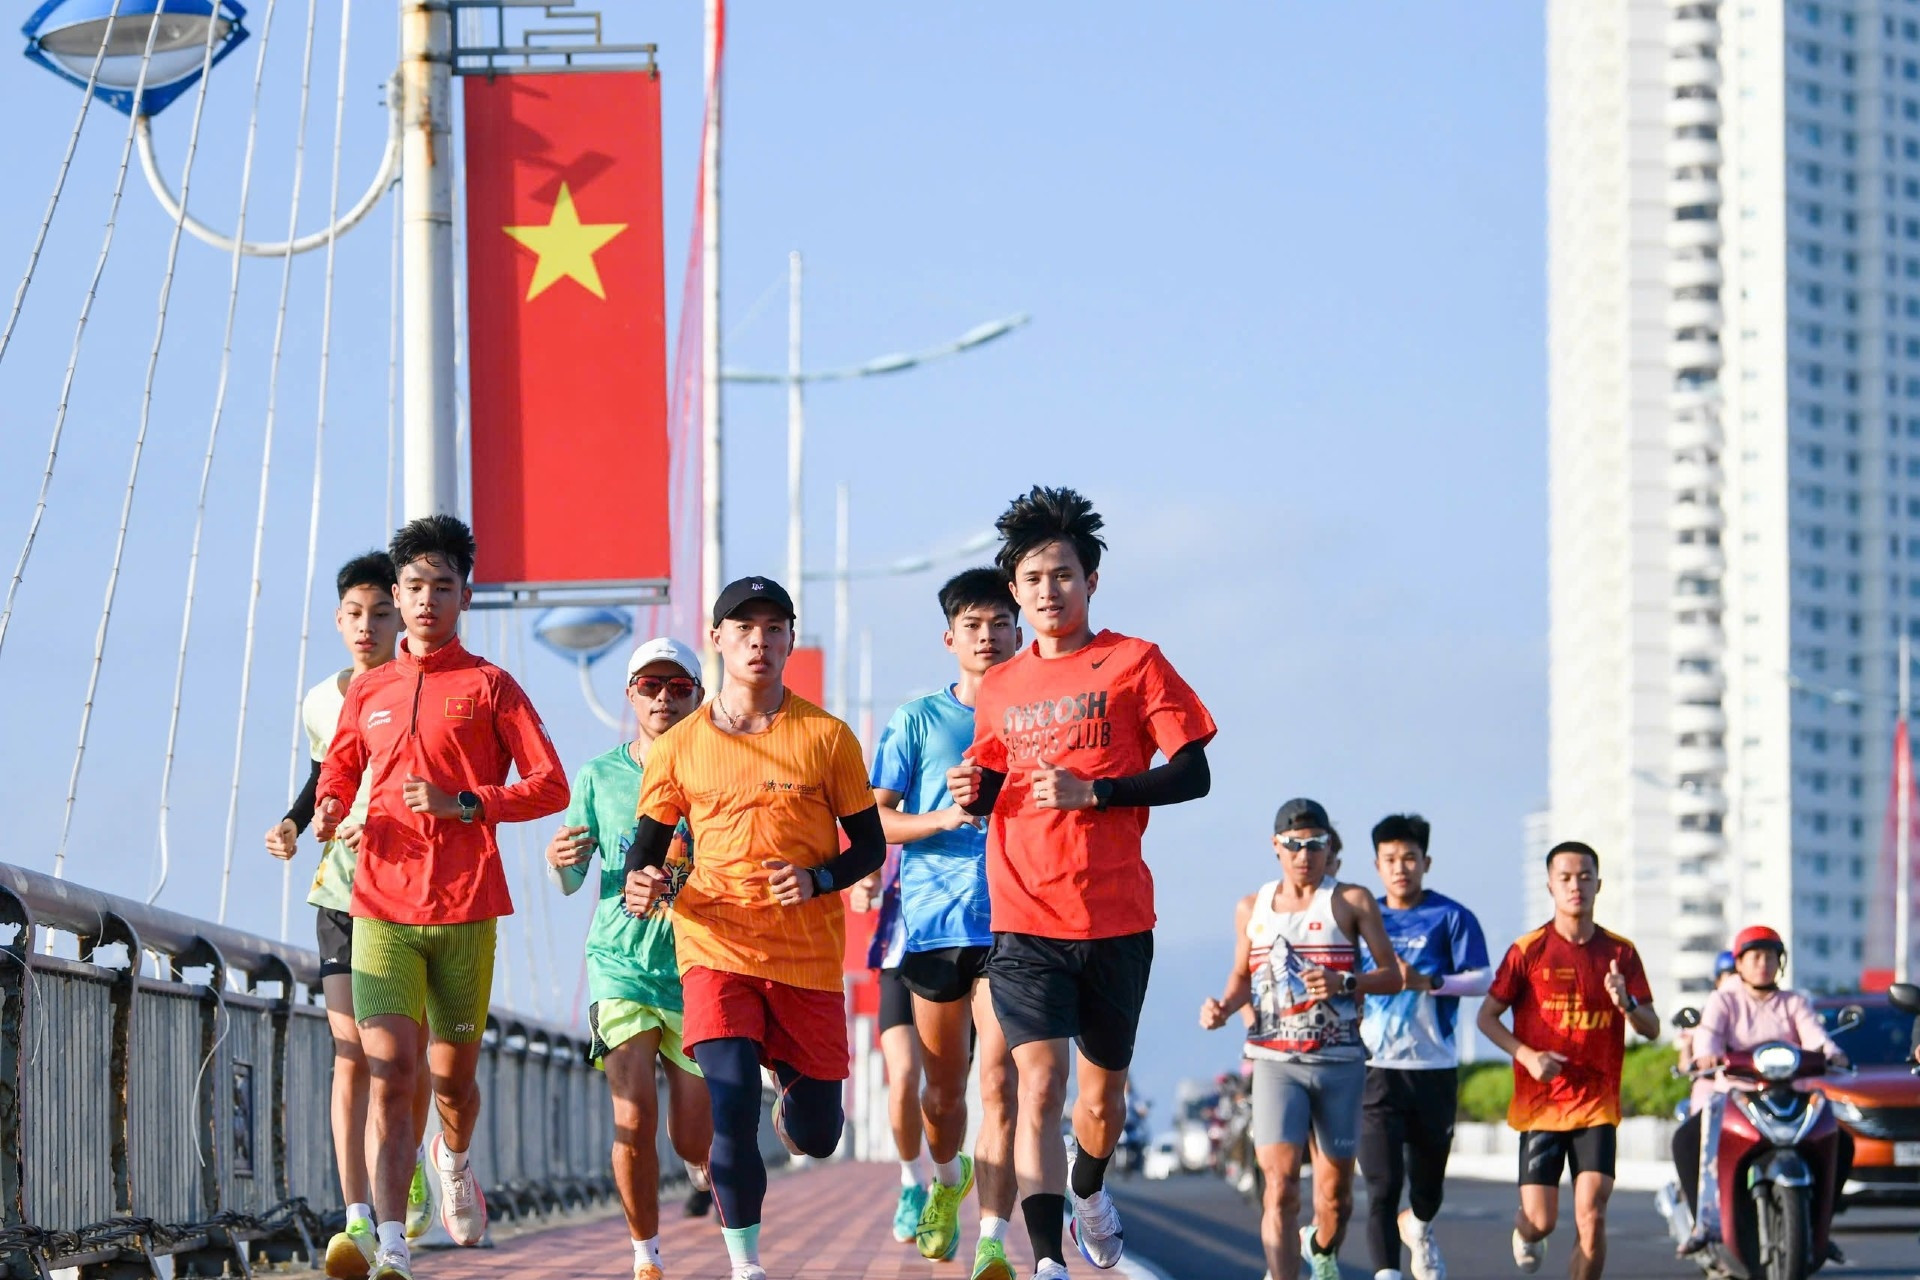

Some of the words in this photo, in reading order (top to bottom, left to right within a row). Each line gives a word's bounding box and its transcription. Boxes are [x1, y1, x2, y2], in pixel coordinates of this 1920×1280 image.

[1003, 691, 1107, 735] SWOOSH
[1066, 721, 1111, 751] CLUB
[1559, 1010, 1613, 1030] RUN
